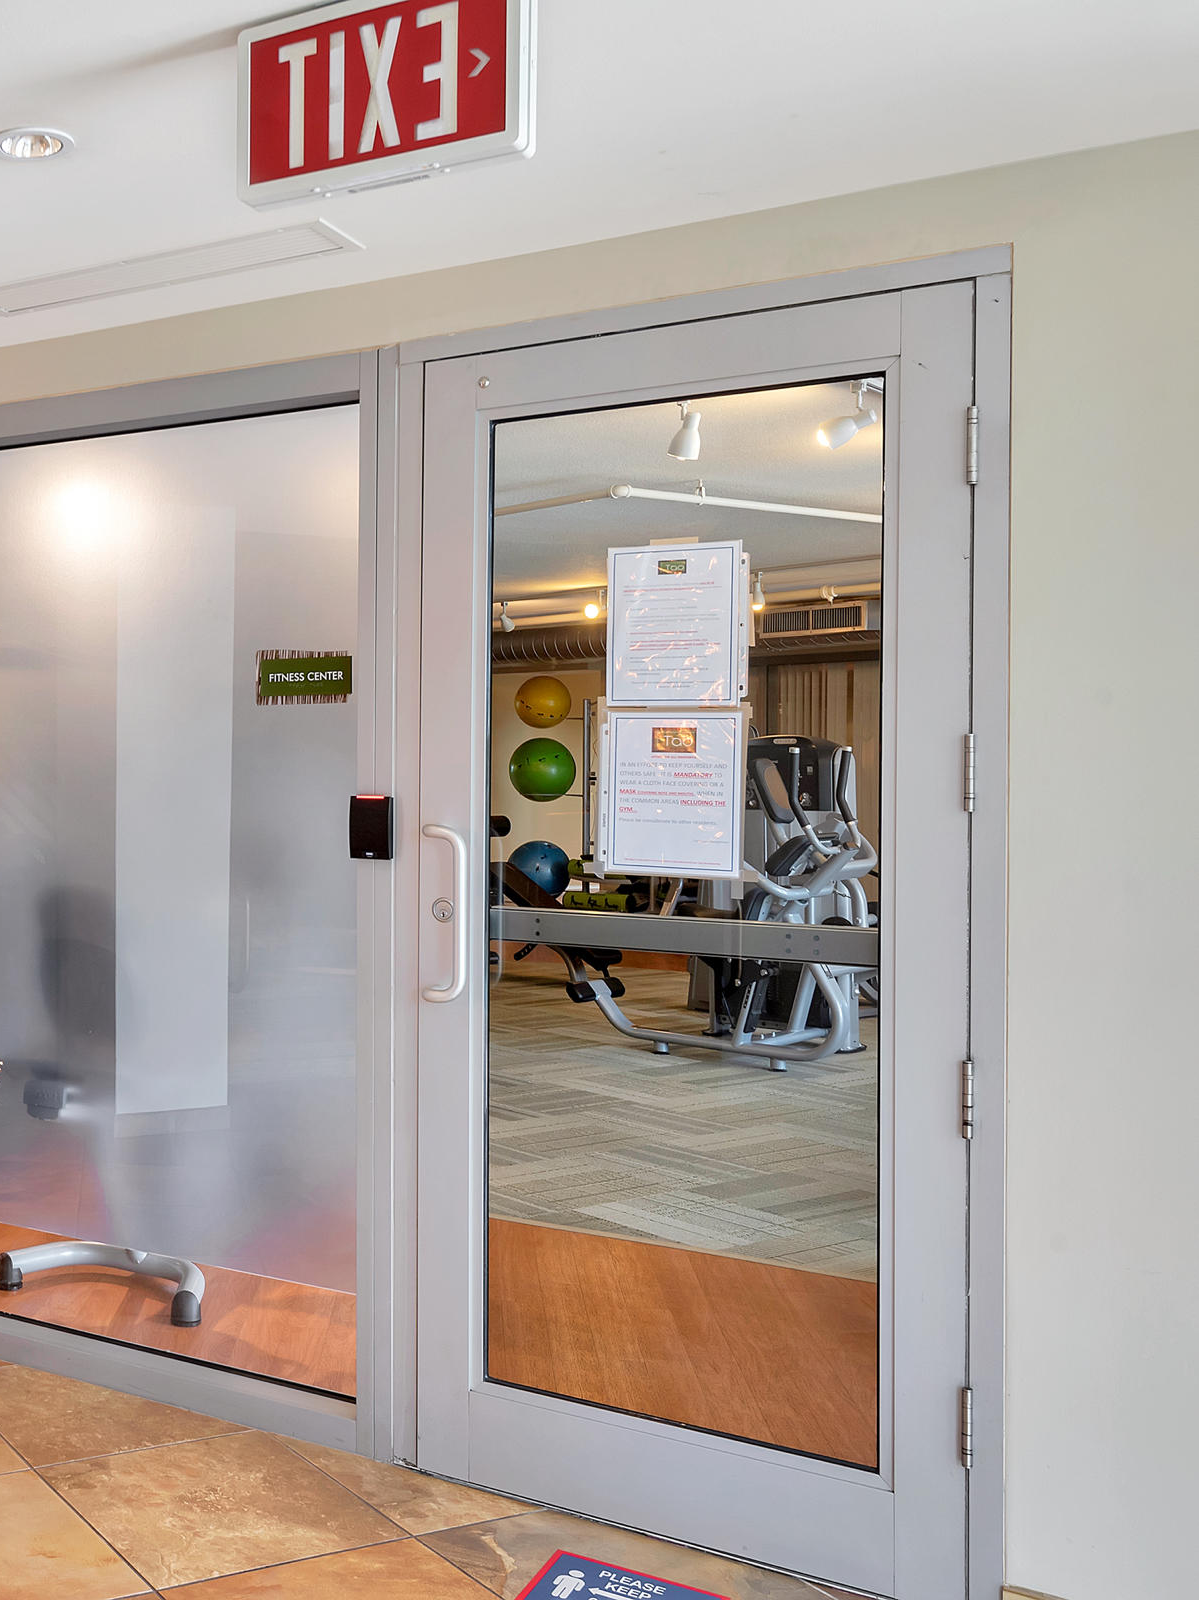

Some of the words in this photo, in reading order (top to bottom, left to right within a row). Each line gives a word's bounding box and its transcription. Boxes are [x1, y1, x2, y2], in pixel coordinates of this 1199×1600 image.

[268, 672, 305, 683] FITNESS
[306, 670, 344, 682] CENTER
[663, 735, 693, 747] Tao
[680, 799, 713, 807] INCLUDING
[598, 1570, 667, 1596] PLEASE
[604, 1582, 652, 1600] KEEP
